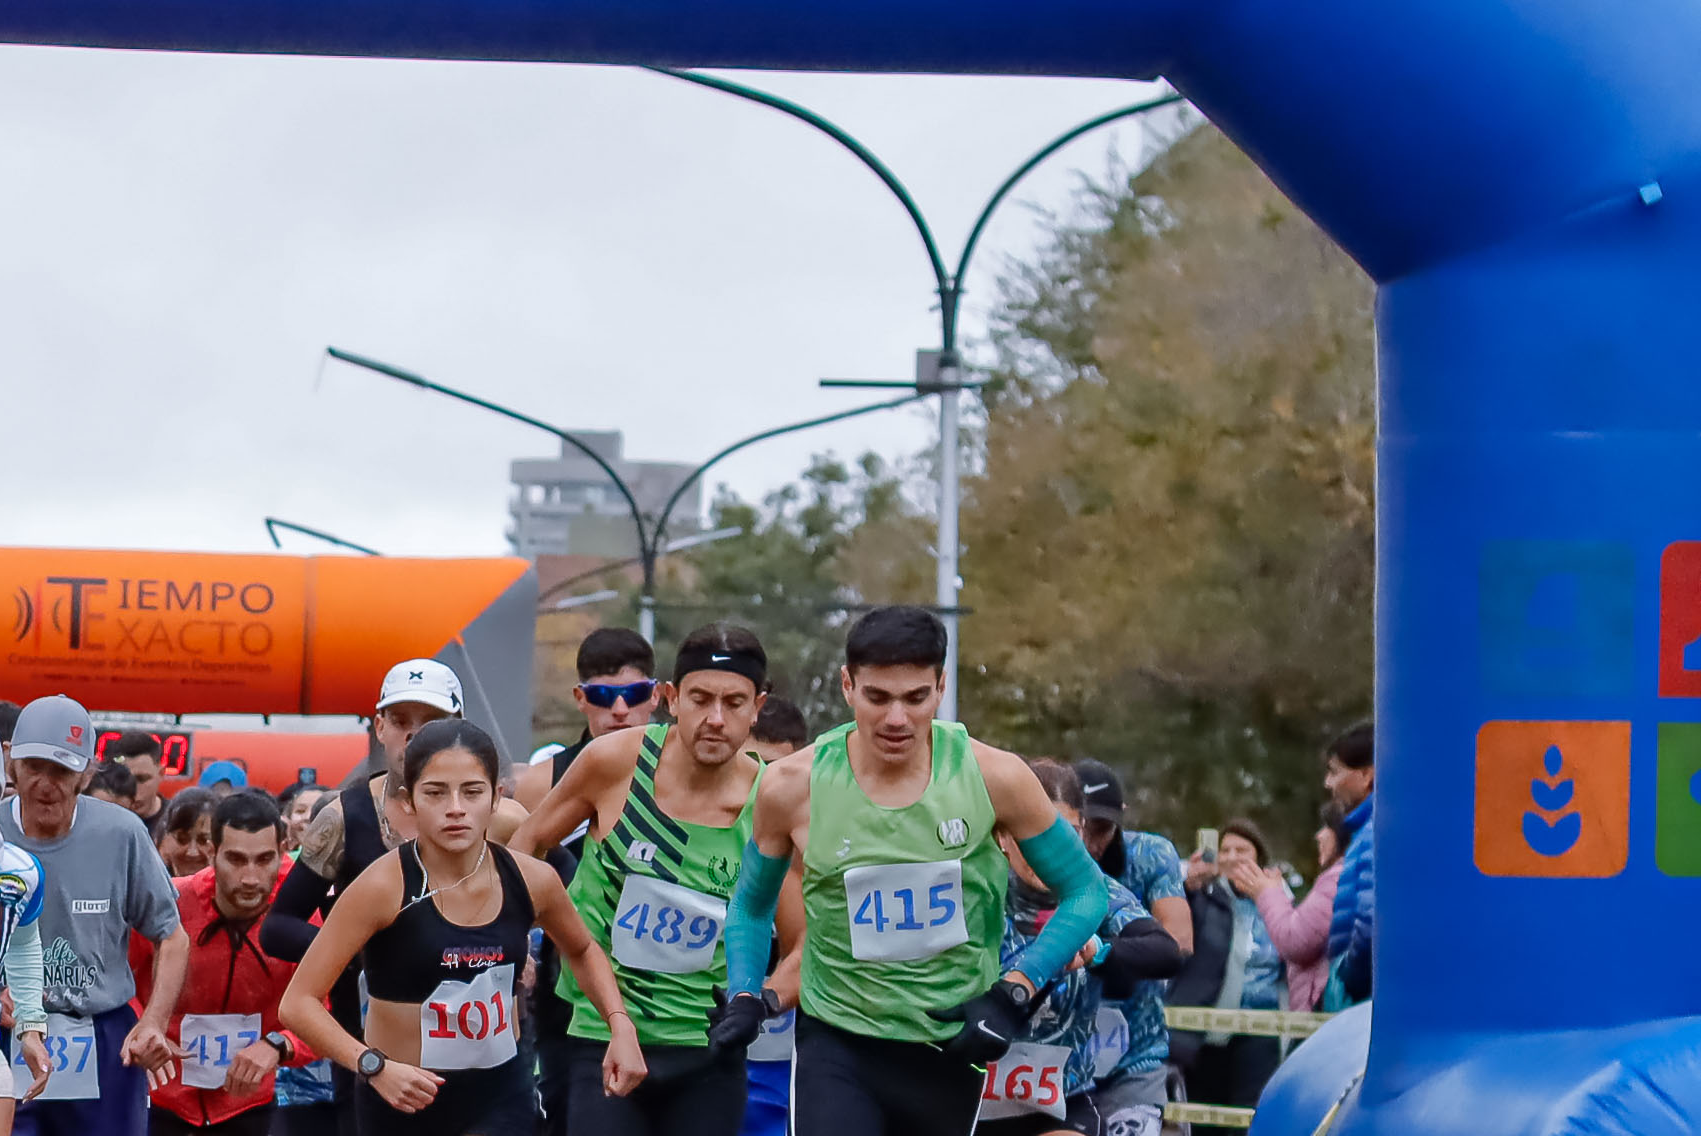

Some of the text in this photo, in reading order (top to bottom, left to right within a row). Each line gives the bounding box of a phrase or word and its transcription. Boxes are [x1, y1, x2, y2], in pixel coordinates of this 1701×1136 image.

[617, 903, 718, 949] 489
[854, 882, 956, 933] 415
[43, 965, 96, 988] NARIAS
[428, 990, 508, 1040] 101
[983, 1062, 1058, 1105] 165
